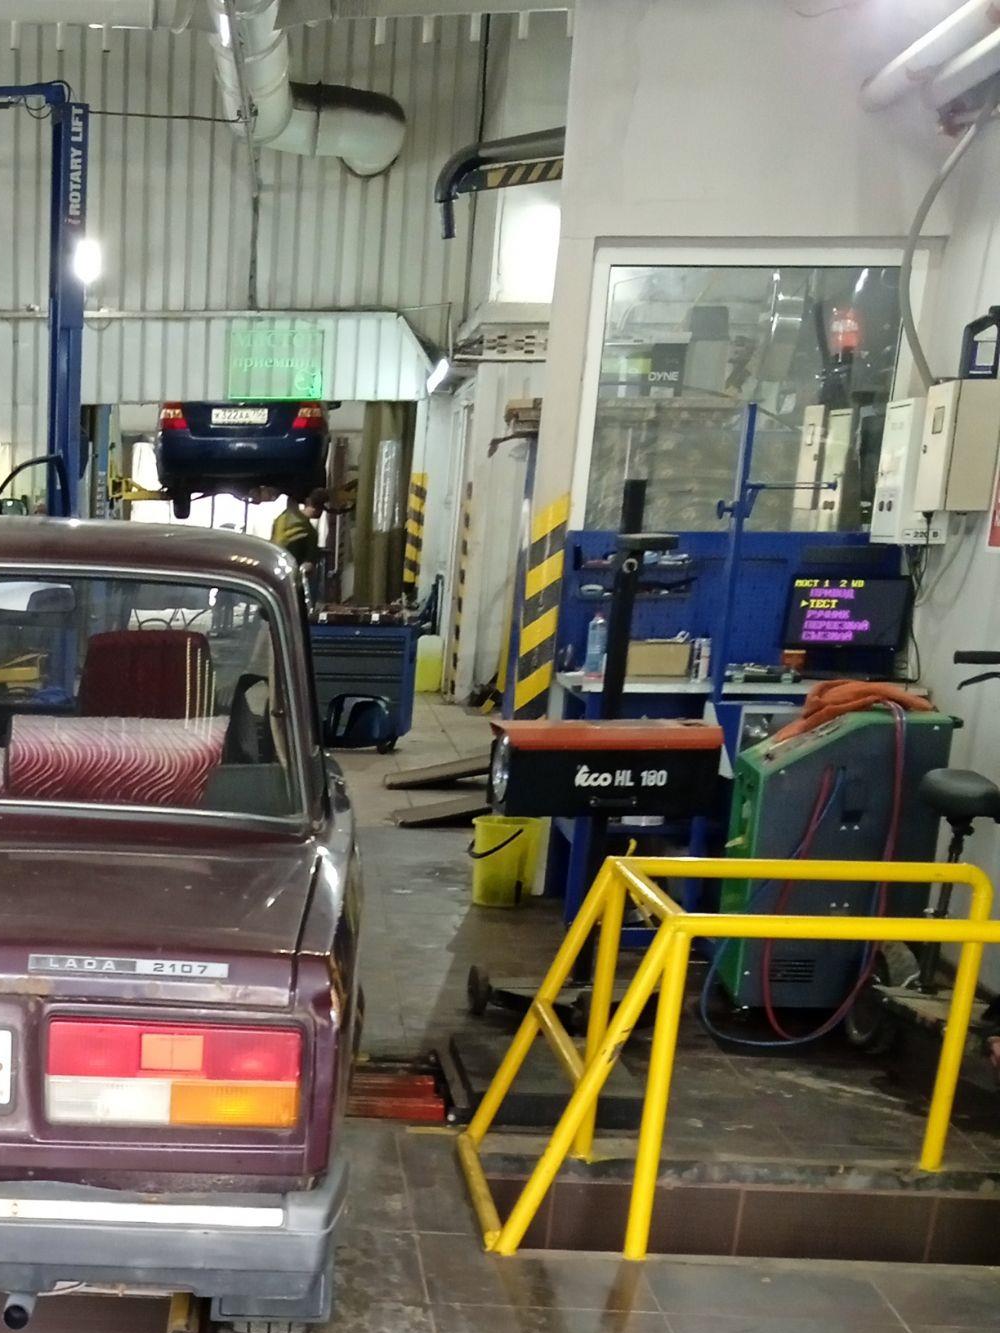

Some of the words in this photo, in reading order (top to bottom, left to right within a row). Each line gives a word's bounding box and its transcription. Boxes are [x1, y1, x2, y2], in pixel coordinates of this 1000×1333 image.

[71, 105, 84, 142] LIFT
[69, 147, 82, 216] ROTARY
[823, 579, 830, 588] 1
[809, 599, 839, 609] ТЕСТ
[614, 770, 635, 787] HL
[640, 769, 668, 787] 180
[49, 957, 117, 971] LADA
[152, 962, 208, 975] 2107
